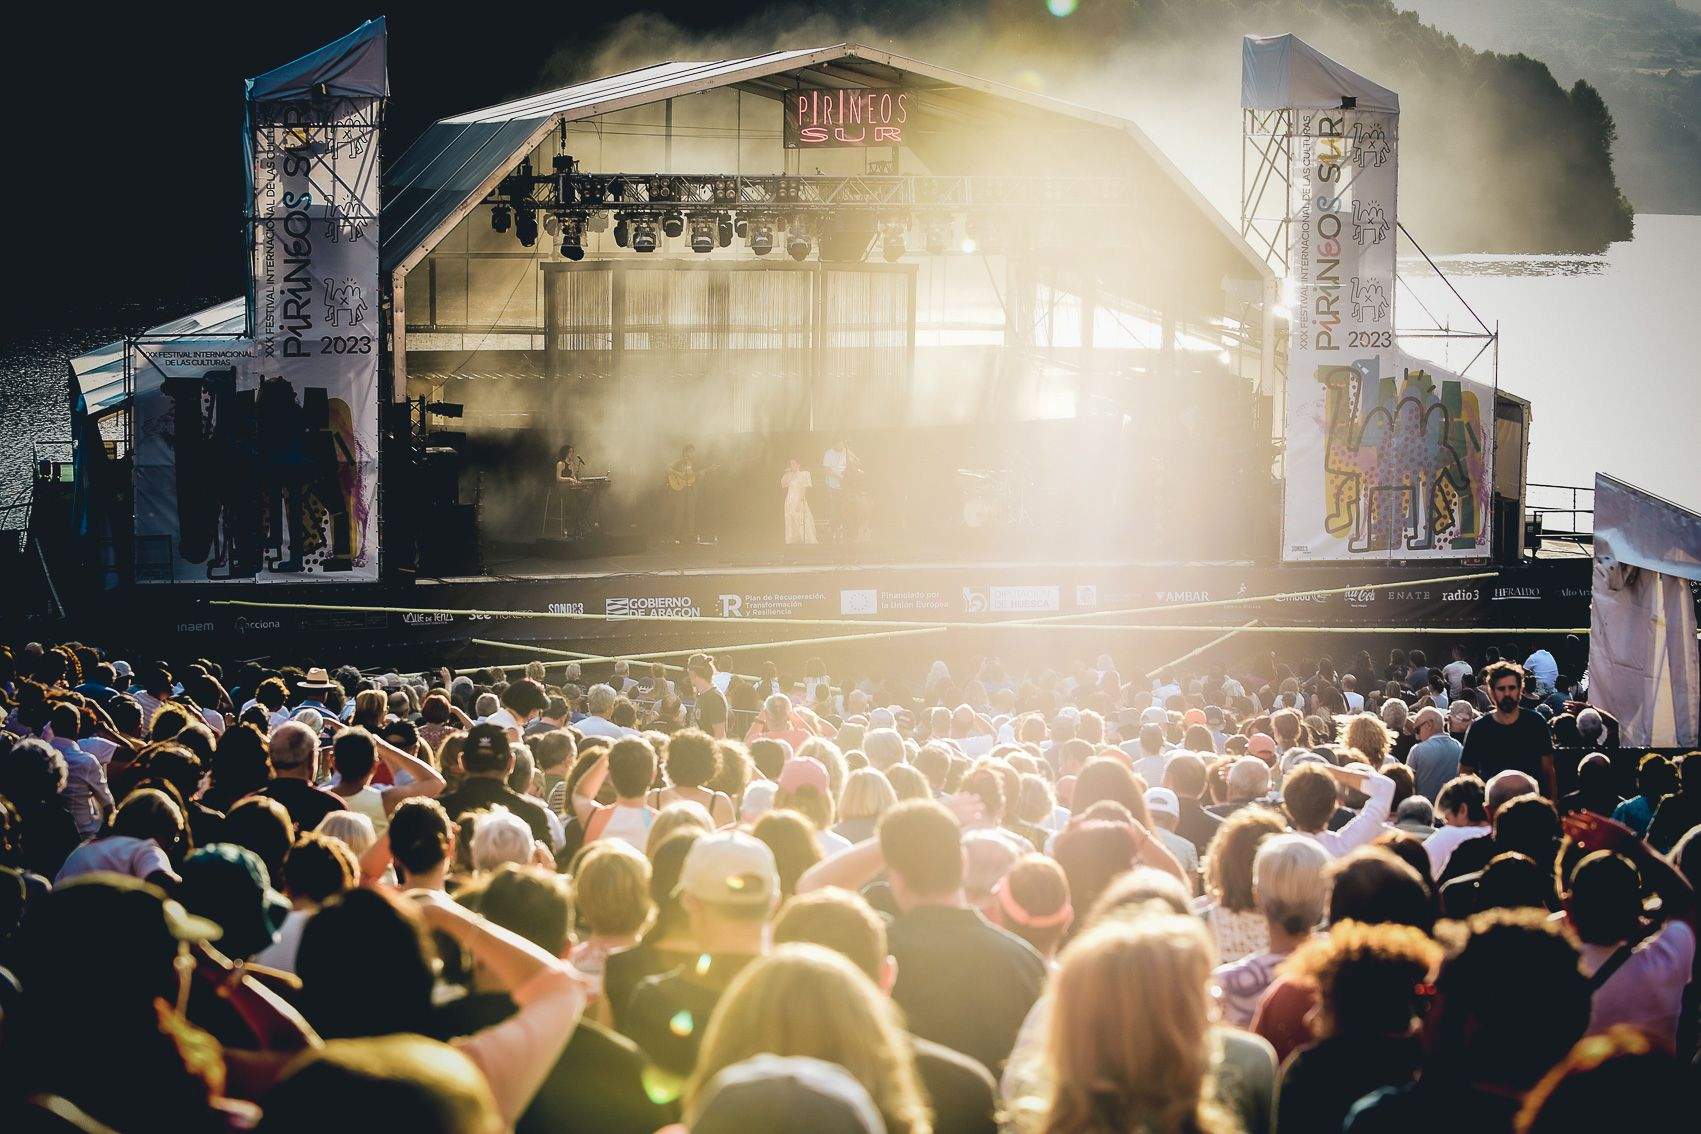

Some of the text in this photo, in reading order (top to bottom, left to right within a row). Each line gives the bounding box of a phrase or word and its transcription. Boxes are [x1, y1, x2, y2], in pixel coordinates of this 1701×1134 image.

[798, 89, 907, 126] PIRINEOS
[800, 127, 902, 142] SUR
[266, 159, 276, 181] LAS
[266, 181, 276, 197] DE
[1300, 115, 1311, 350] XXX FESTIVAL INTERNACIONAL DE LAS CULTURAS
[265, 200, 276, 285] INTERNACIONAL
[265, 287, 275, 335] FESTIVAL
[320, 335, 372, 354] 2023
[1348, 331, 1392, 348] 2023
[158, 351, 193, 359] FESTIVAL
[193, 350, 253, 358] INTERNACIONAL
[265, 340, 275, 358] XXX
[1167, 591, 1209, 602] AMBAR
[1388, 591, 1430, 600] ENATE
[1442, 589, 1480, 601] radio3
[1494, 588, 1541, 597] HERALDO
[629, 597, 692, 609] GOBIERNO
[745, 600, 802, 609] Transformación
[629, 609, 646, 617] DE
